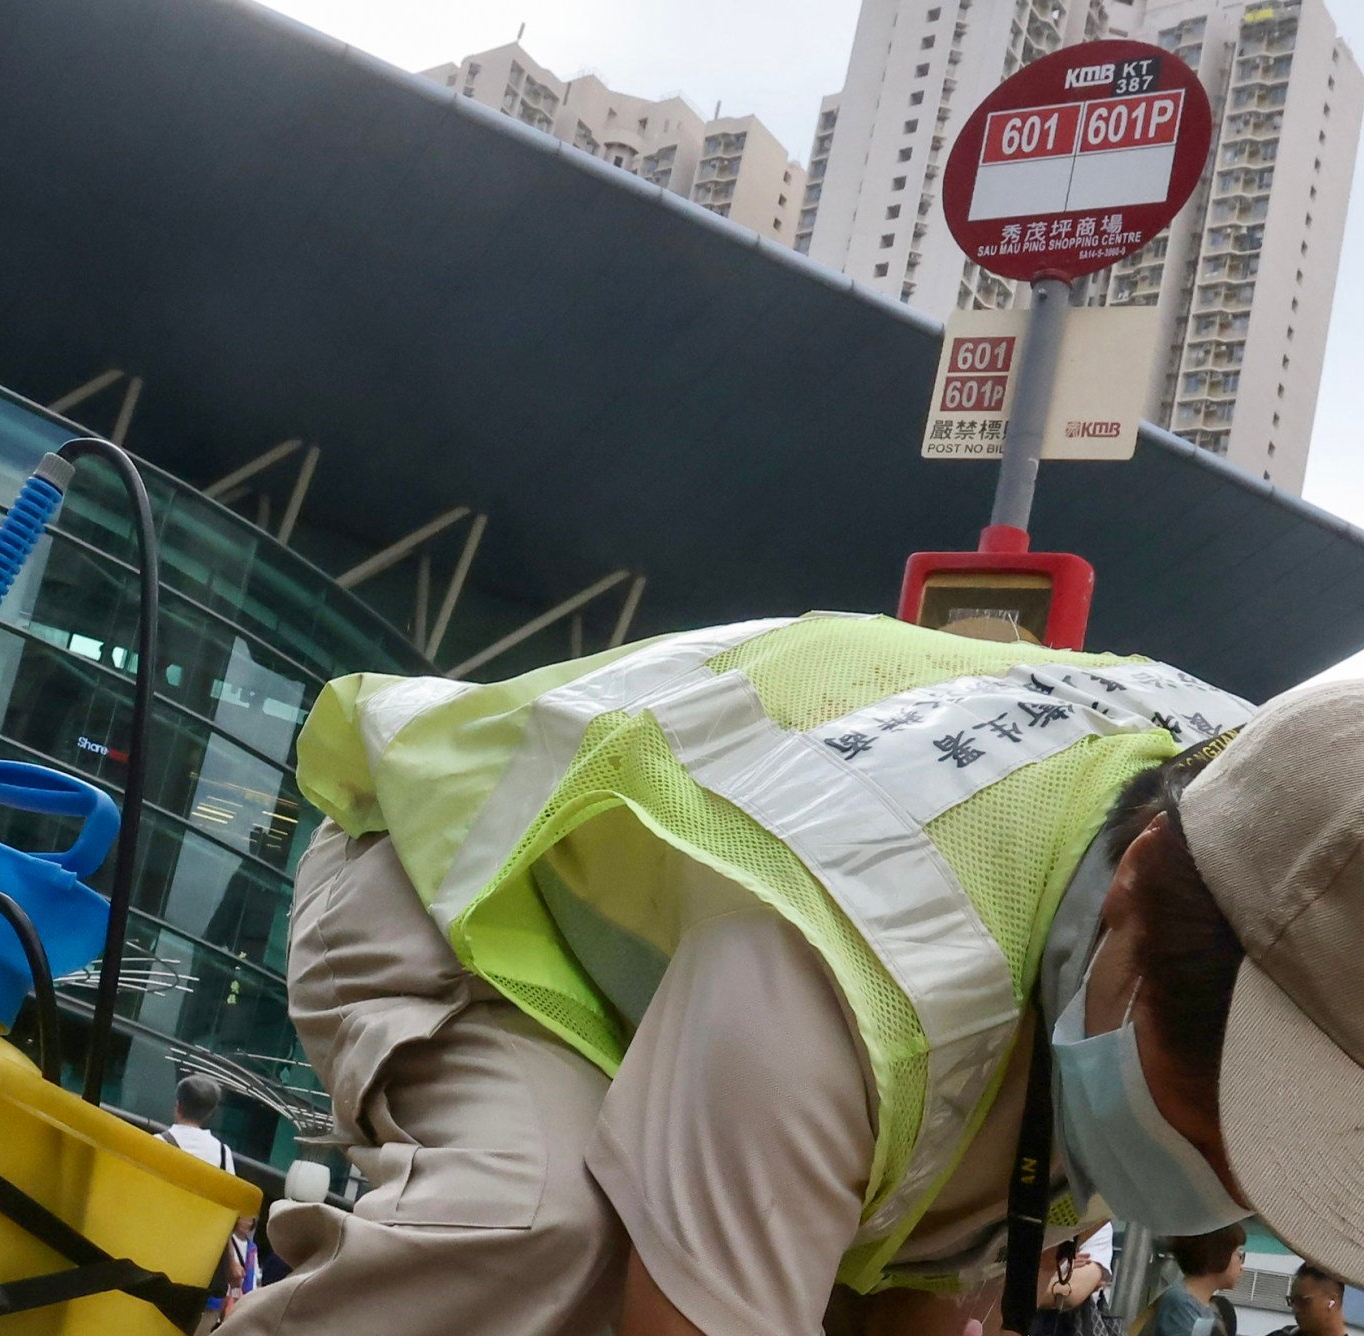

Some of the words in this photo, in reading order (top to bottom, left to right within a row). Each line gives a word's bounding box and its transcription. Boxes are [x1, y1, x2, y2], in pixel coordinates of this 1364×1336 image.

[1064, 64, 1115, 89] KMB
[1123, 60, 1152, 77] KT
[1115, 76, 1153, 94] 387
[1002, 113, 1058, 155] 601
[1088, 99, 1174, 145] 601P
[1000, 214, 1123, 244] 秀茂坪商場
[977, 244, 998, 257] SAU
[999, 242, 1021, 255] MAU
[1022, 240, 1046, 253] PING
[1049, 235, 1099, 251] SHOPPING
[1101, 231, 1142, 246] CENTRE
[957, 341, 1007, 370] 601
[946, 380, 1004, 408] 601P
[929, 420, 1009, 441] 嚴禁標
[1081, 421, 1121, 438] KMB
[928, 443, 962, 454] POST
[964, 443, 983, 454] NO
